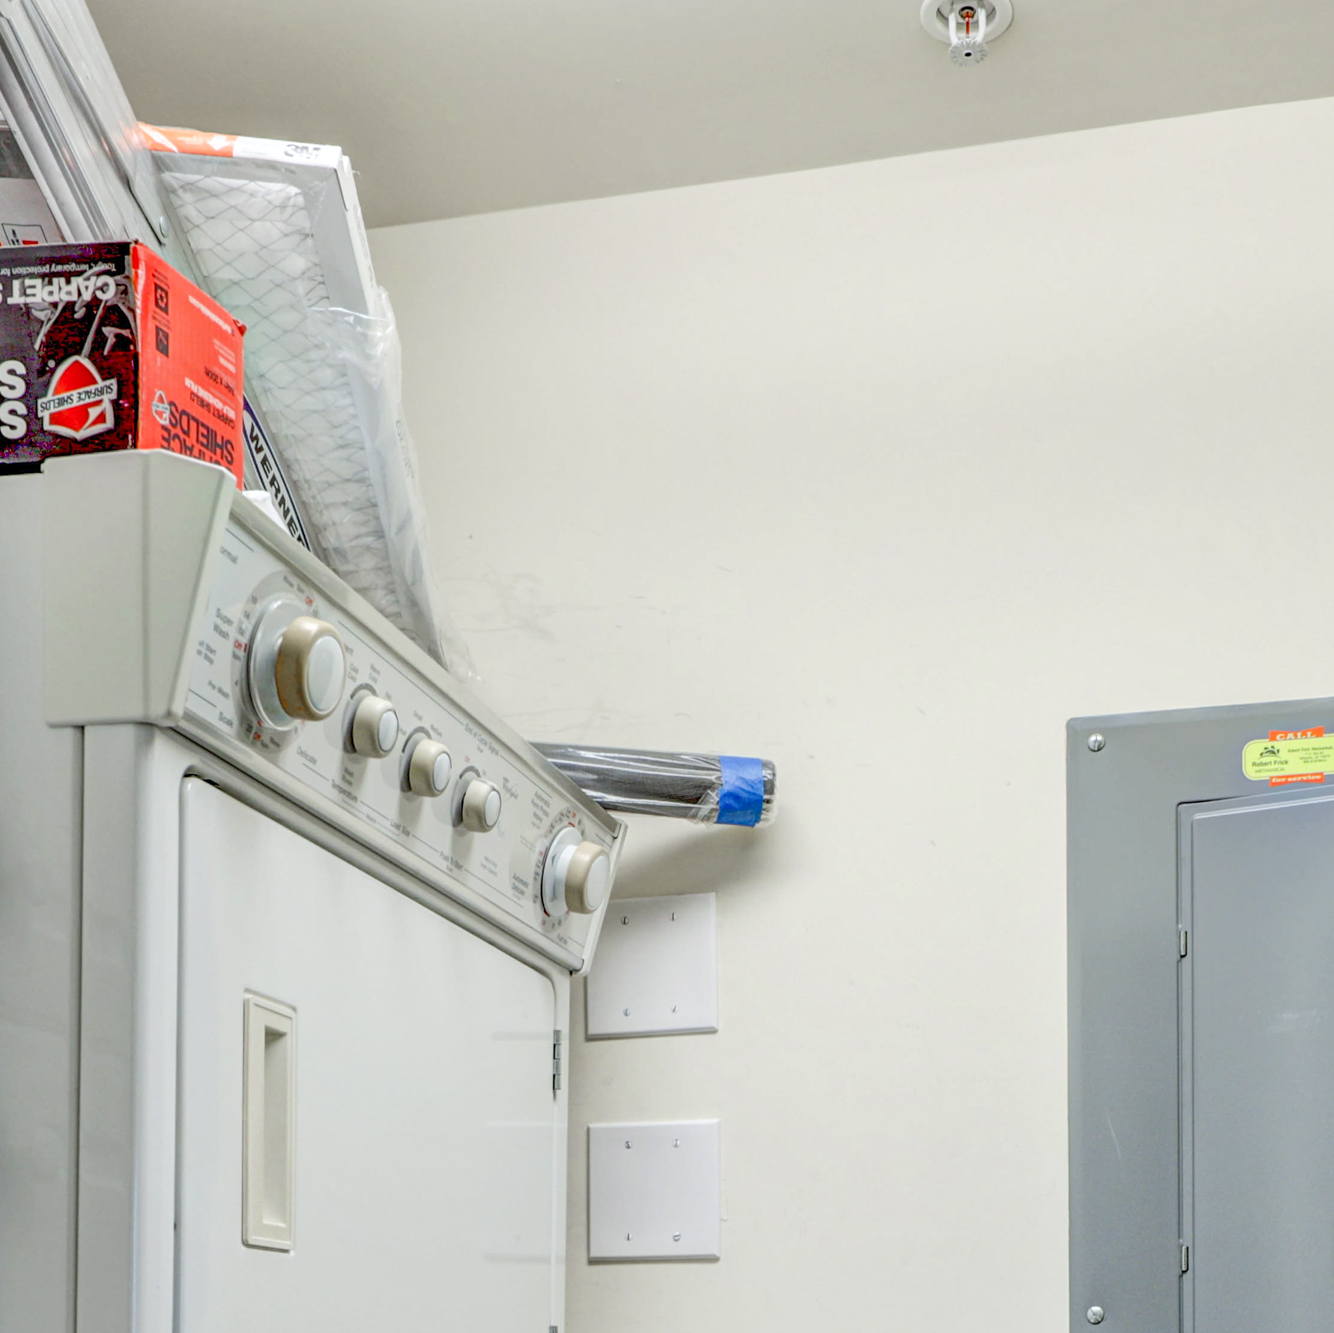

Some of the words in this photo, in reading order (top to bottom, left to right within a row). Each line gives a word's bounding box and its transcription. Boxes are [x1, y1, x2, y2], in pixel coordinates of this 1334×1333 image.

[0, 268, 11, 277] for
[12, 265, 50, 275] protection
[51, 262, 90, 273] temporary
[7, 274, 117, 304] CARPET
[77, 383, 114, 404] SURFACE
[40, 394, 74, 413] SHIELDS
[169, 401, 234, 466] SHIELDS
[215, 607, 234, 627] Super
[213, 622, 229, 640] Wash
[1276, 731, 1316, 740] CALL
[1287, 774, 1322, 782] service
